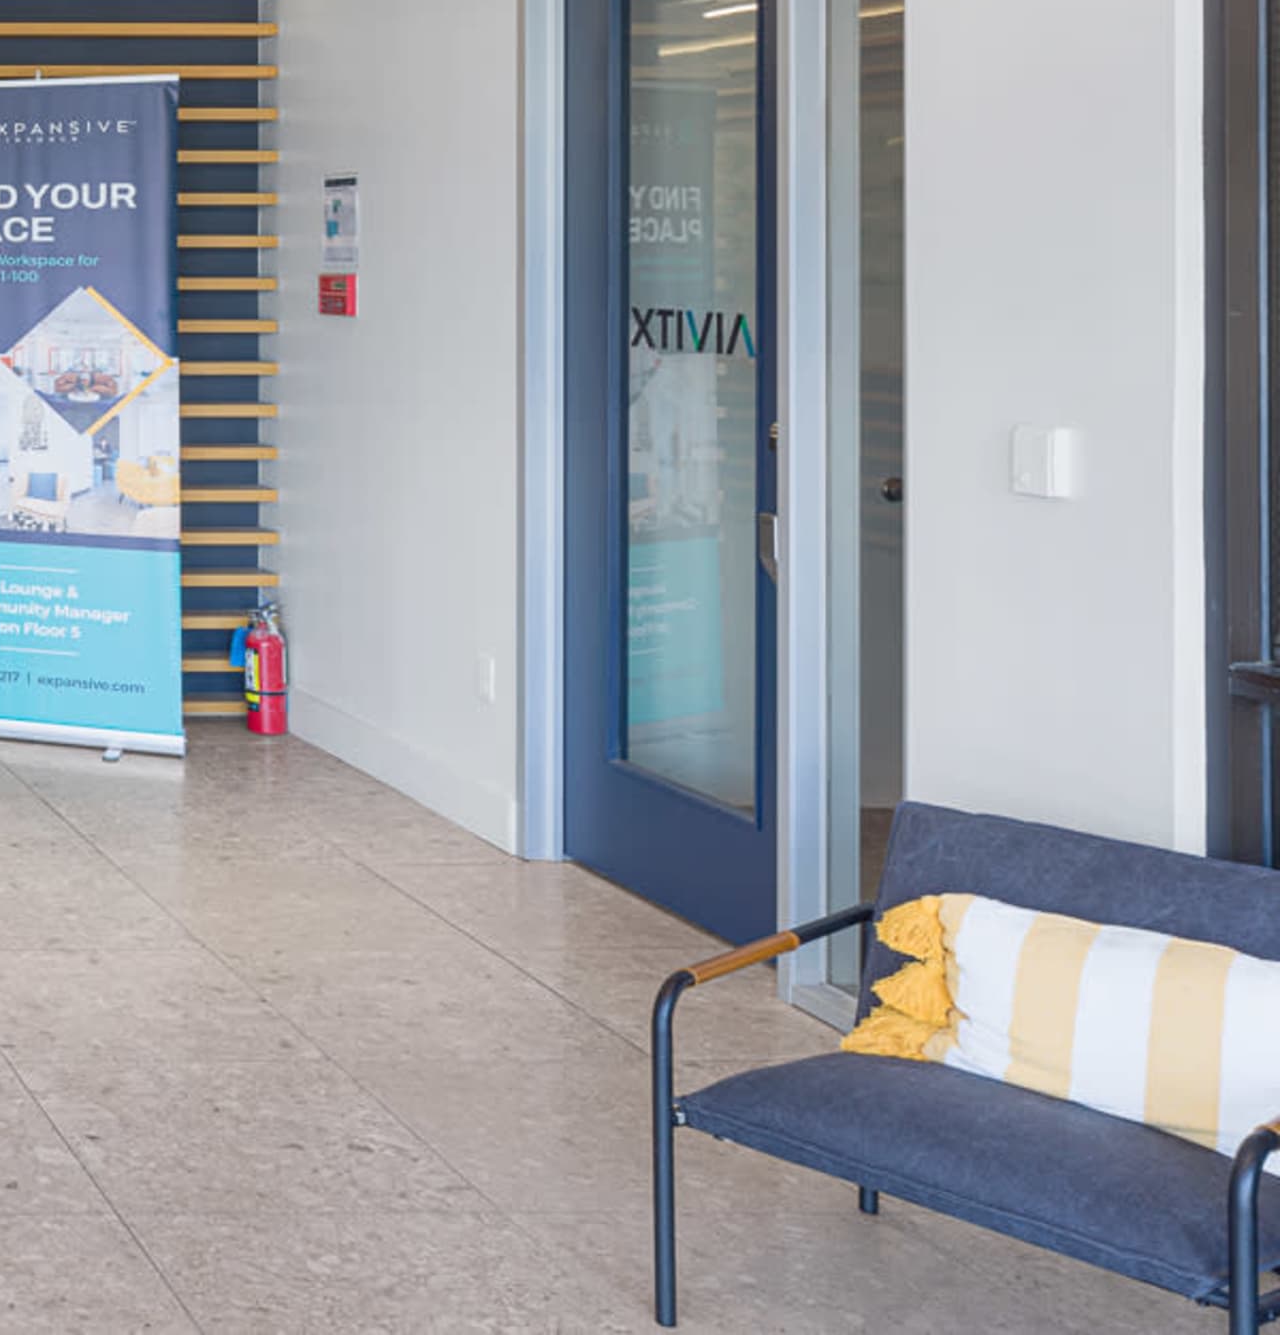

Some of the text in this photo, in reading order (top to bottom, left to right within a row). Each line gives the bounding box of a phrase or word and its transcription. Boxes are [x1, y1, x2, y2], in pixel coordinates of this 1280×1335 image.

[24, 181, 137, 210] YOUR
[78, 253, 100, 266] for
[0, 269, 39, 282] 1-100
[631, 307, 755, 359] XTIVIA
[0, 580, 79, 600] Lounge &
[54, 604, 131, 624] Manager
[0, 622, 20, 636] on
[24, 622, 66, 639] Floor
[37, 676, 145, 694] expansive.com
